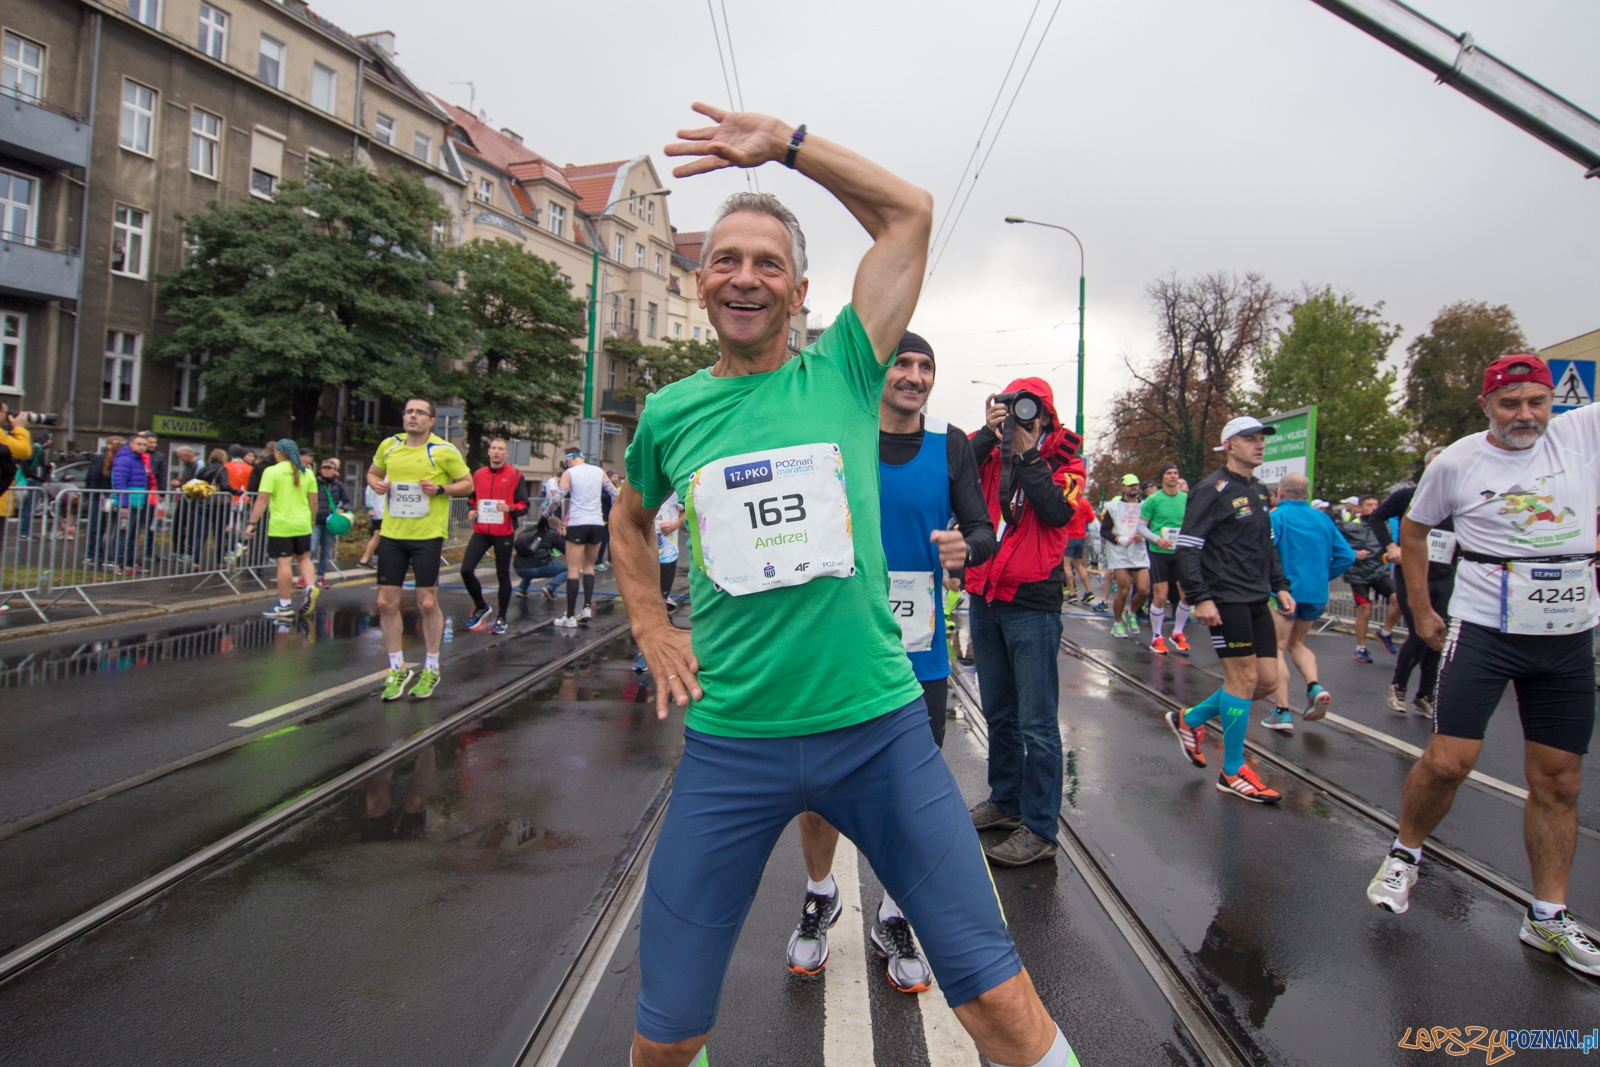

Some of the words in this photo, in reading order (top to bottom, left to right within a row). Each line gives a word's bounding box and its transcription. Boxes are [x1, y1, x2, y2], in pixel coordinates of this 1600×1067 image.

[162, 418, 211, 434] KWIATY
[1281, 440, 1305, 453] ENTRANCE
[776, 464, 814, 476] maraton
[396, 493, 422, 503] 2653
[743, 493, 807, 530] 163
[755, 529, 809, 550] Andrzej
[1431, 540, 1447, 550] 818
[1527, 586, 1586, 604] 4243
[1543, 606, 1576, 614] Edward
